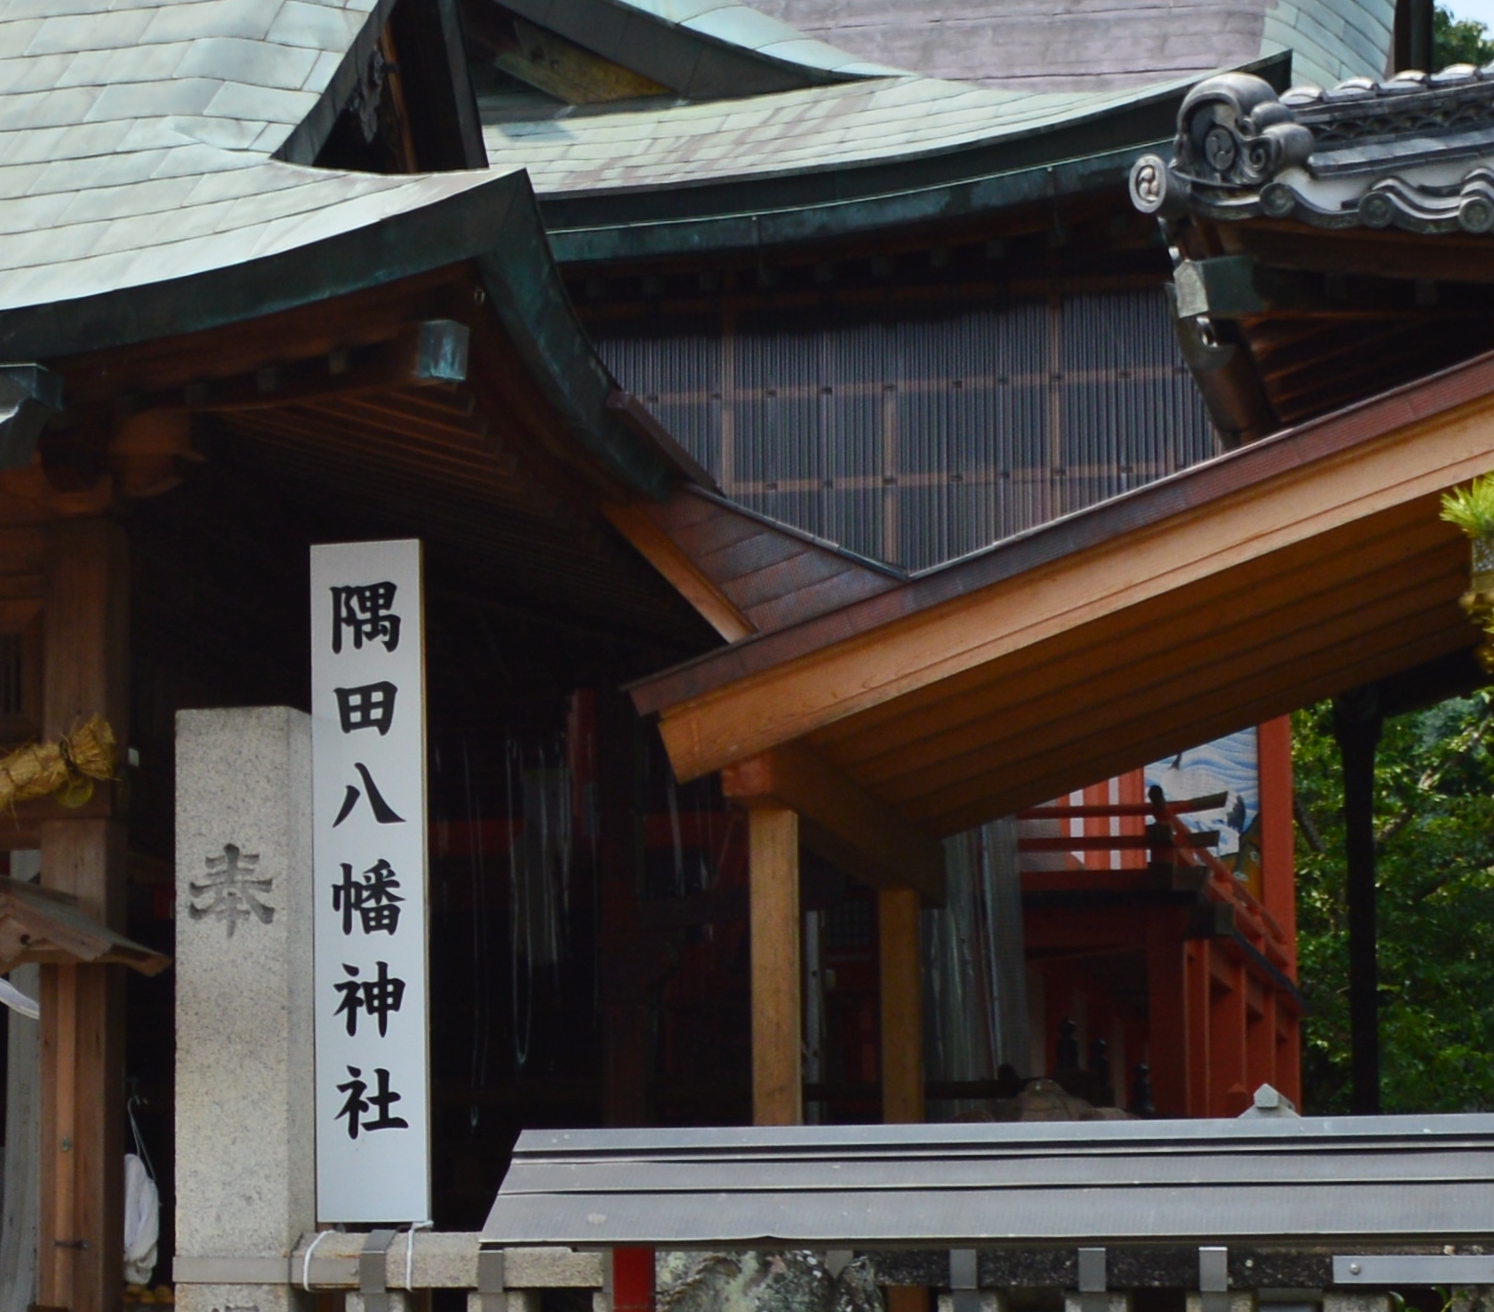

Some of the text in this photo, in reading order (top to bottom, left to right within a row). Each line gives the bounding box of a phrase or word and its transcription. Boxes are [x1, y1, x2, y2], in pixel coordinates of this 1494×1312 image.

[330, 580, 410, 1140] 隅田八幡神社
